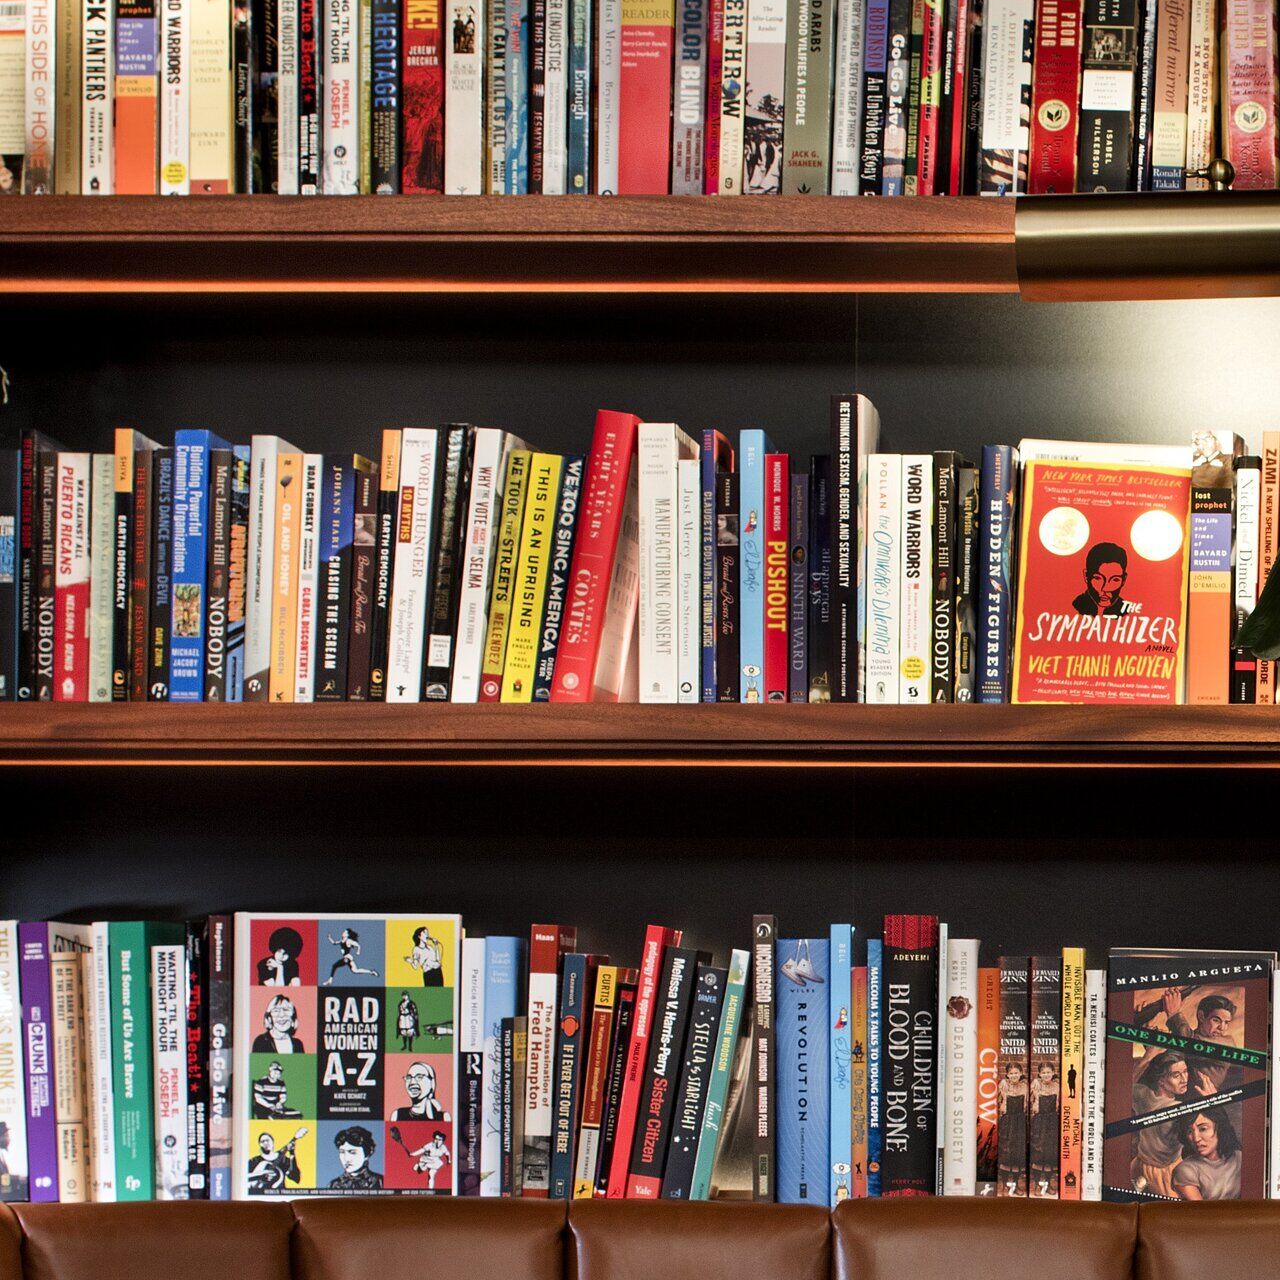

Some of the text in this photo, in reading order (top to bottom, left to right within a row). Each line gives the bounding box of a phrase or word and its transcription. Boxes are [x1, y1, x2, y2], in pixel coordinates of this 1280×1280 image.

[811, 12, 822, 52] ARABS
[86, 29, 105, 100] PANTHERS
[681, 65, 701, 124] BLIND
[906, 464, 922, 579] WORD WARRIORS
[1195, 491, 1211, 499] lost
[1195, 501, 1227, 510] prophet
[520, 467, 550, 627] THIS IS AN UPRISING
[1194, 549, 1227, 557] BAYARD
[567, 569, 590, 644] COATES
[767, 541, 786, 632] PUSHOUT
[986, 500, 1003, 677] HIDDEN FIGURES
[1121, 601, 1142, 613] THE
[935, 599, 950, 681] NOBODY
[1028, 612, 1176, 643] SYMPATHIZER
[1028, 655, 1176, 679] VIET THANH NGUYEN
[1117, 964, 1263, 985] MANLIO ARGUETA
[325, 997, 379, 1023] RAD
[325, 1023, 378, 1034] AMERICAN
[323, 1053, 377, 1086] A-Z
[324, 1035, 377, 1051] WOMEN
[526, 1001, 543, 1110] Fred Hampton
[797, 1003, 807, 1121] REVOLUTION
[885, 984, 910, 1152] BLOOD AND BONE
[912, 1011, 933, 1131] CHILDREN OF
[1115, 1024, 1260, 1065] ONE DAY OF LIFE
[979, 1047, 998, 1125] crow
[642, 1078, 667, 1162] Sister Citizen
